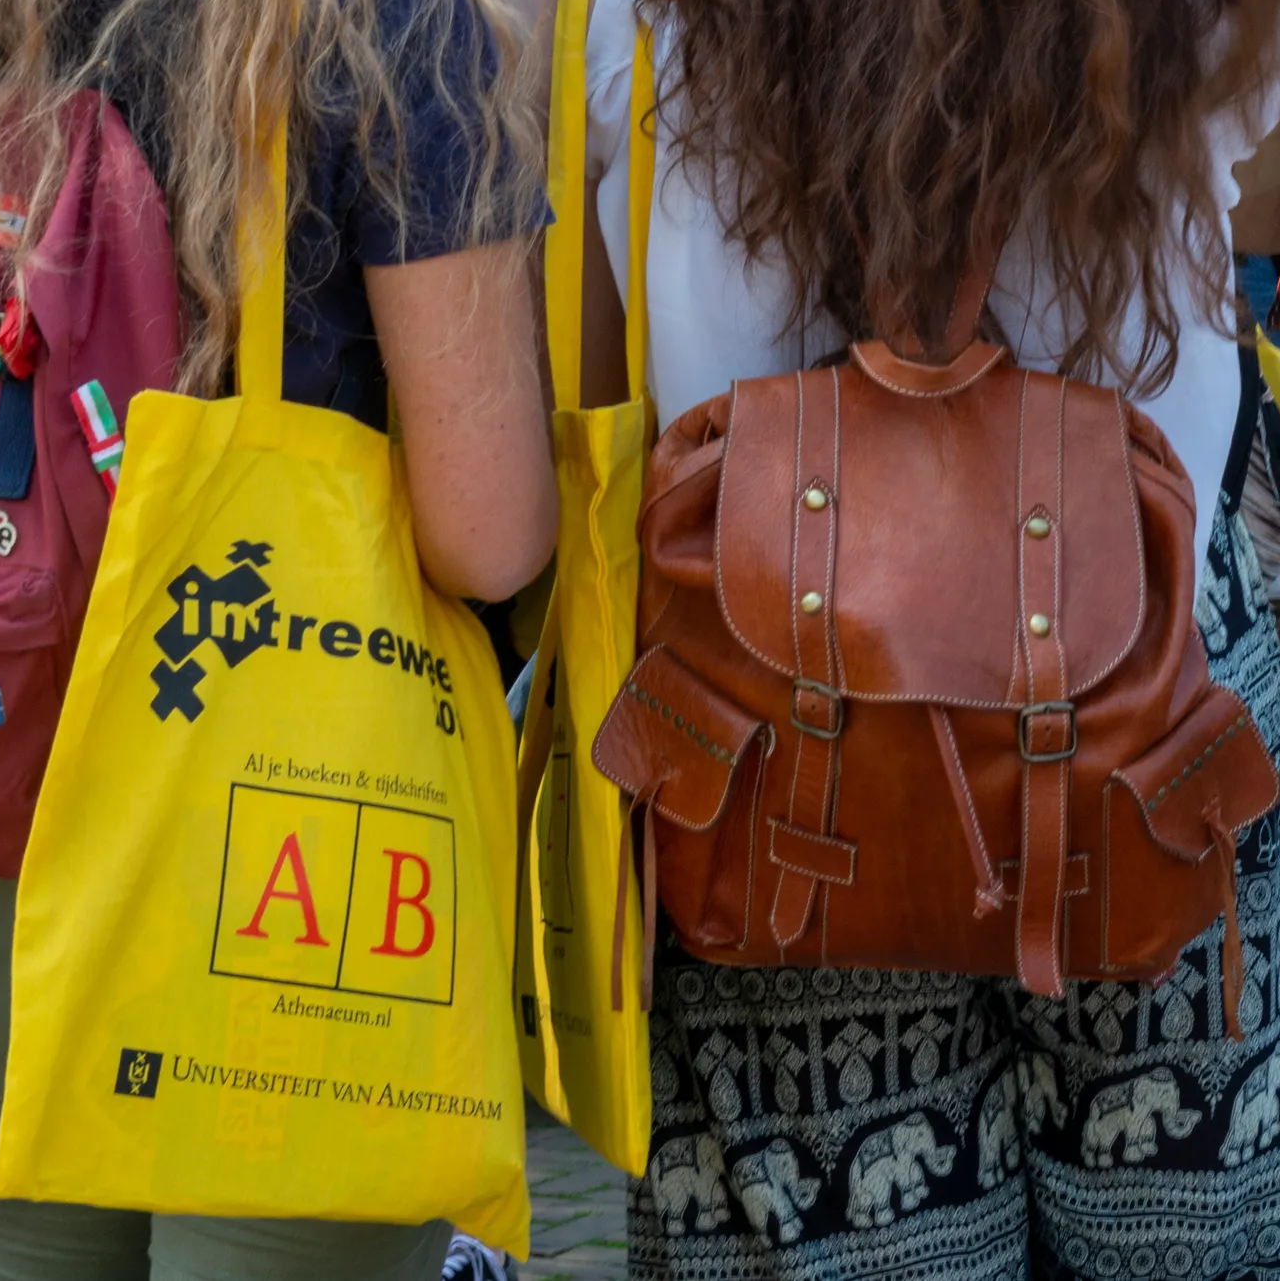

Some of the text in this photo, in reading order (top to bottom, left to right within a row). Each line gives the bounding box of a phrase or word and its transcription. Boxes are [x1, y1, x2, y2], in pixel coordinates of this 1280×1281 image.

[180, 581, 453, 694] intreewee
[244, 752, 448, 805] Al je boeken & tijdschriften
[235, 831, 436, 959] A B
[271, 994, 392, 1028] Athenaeum.nl
